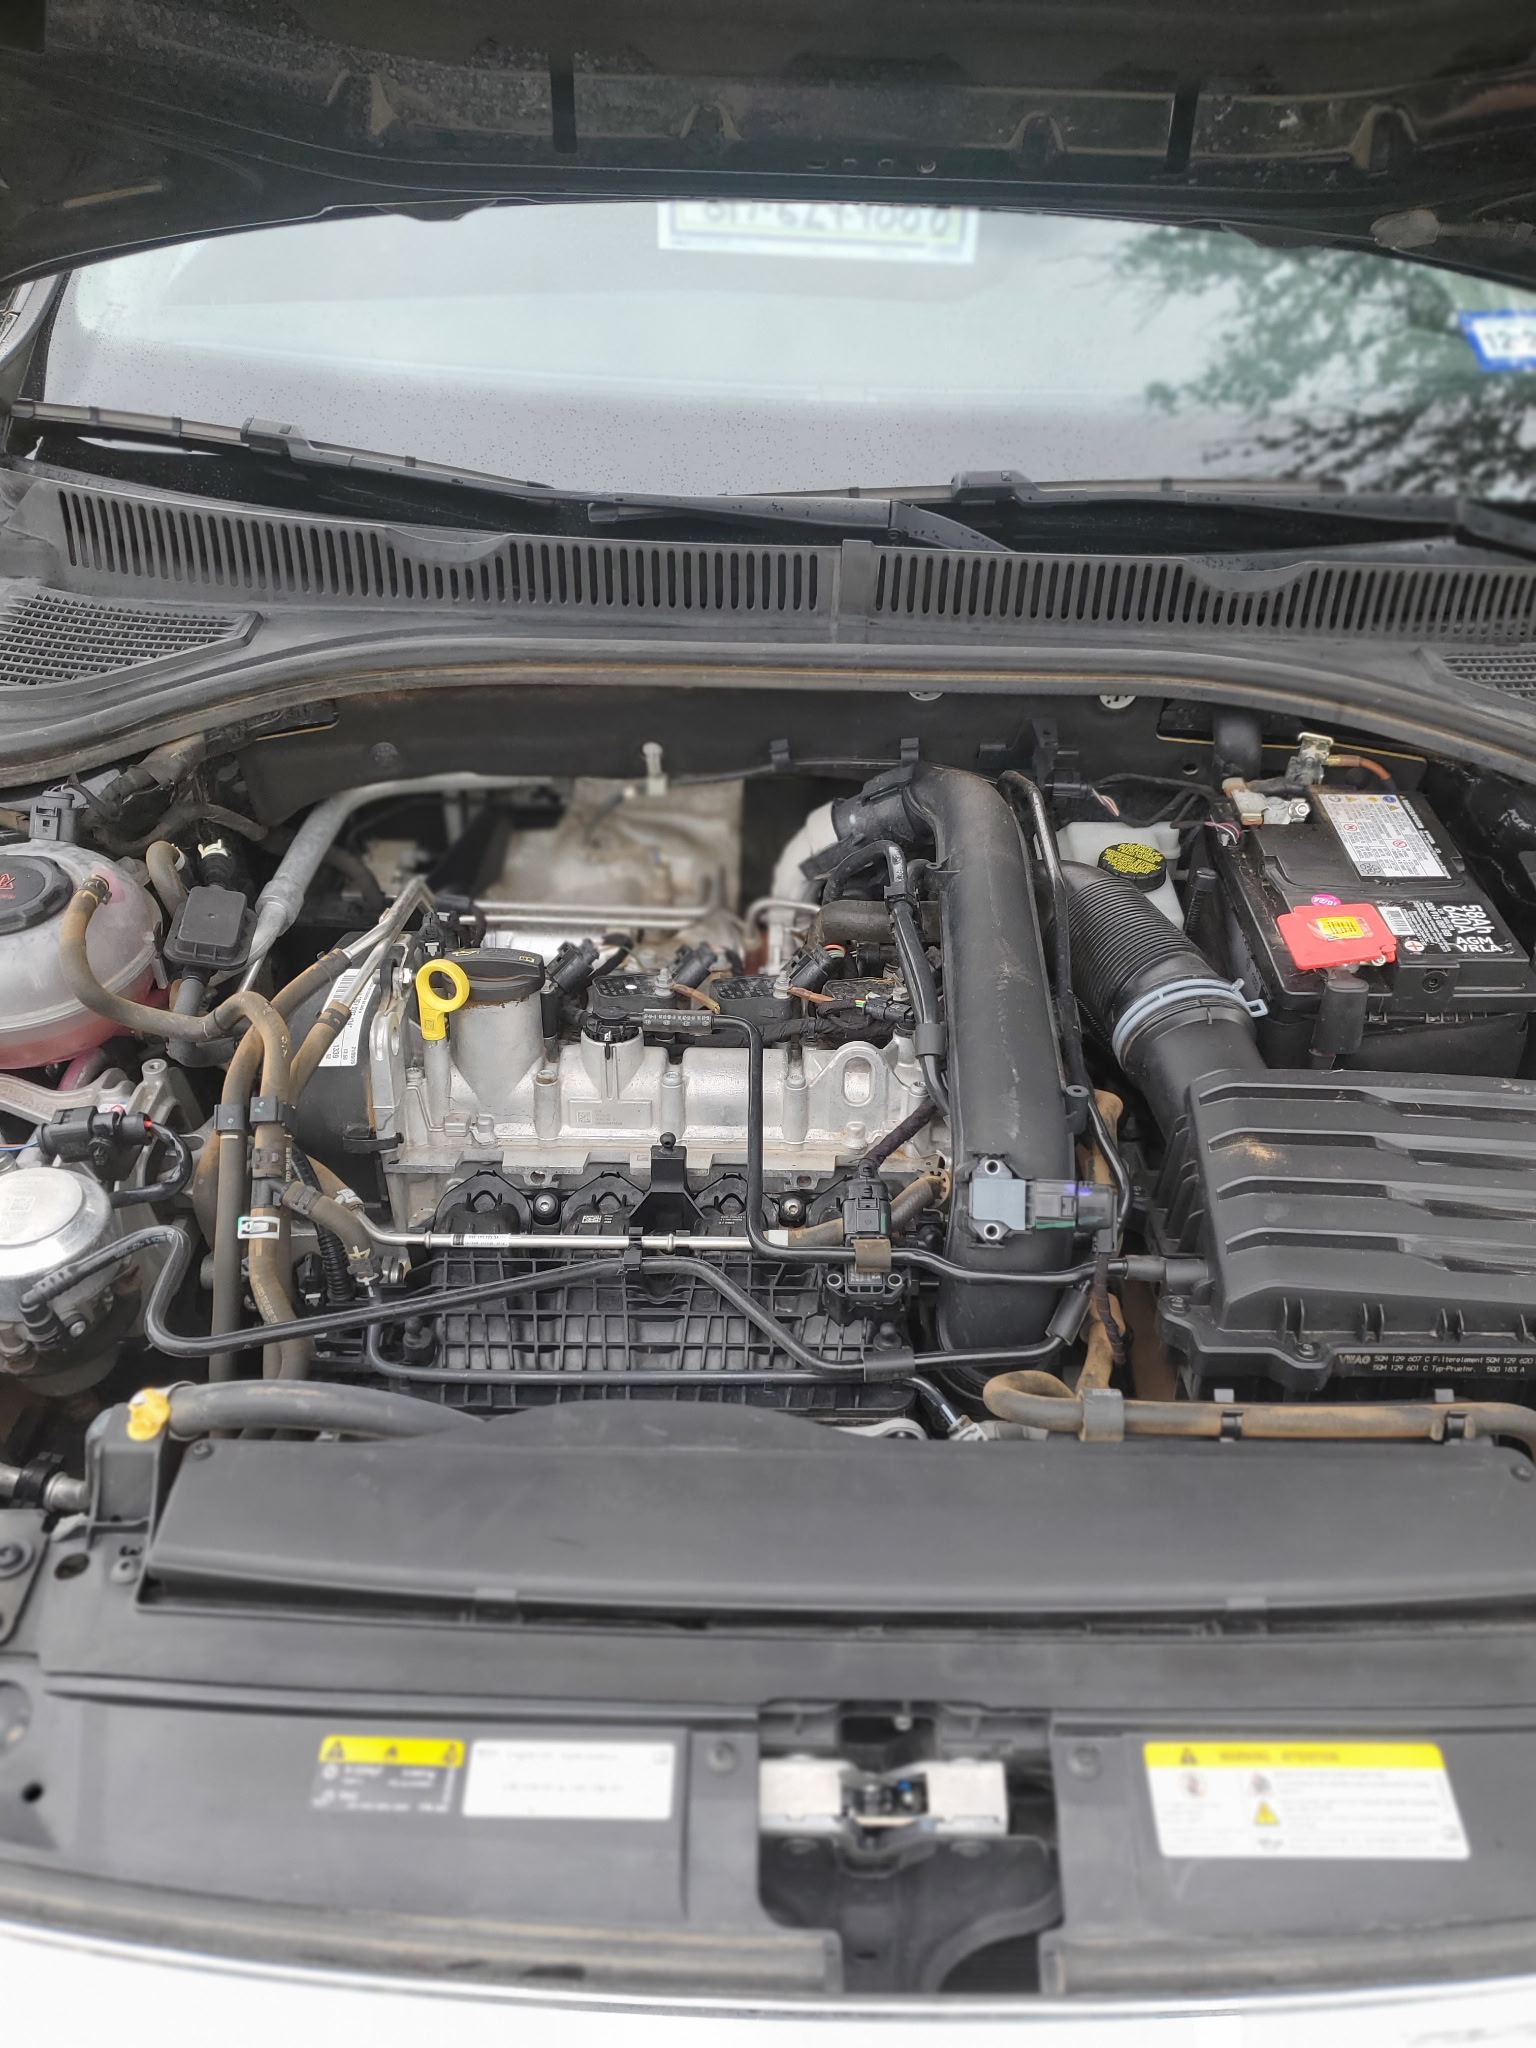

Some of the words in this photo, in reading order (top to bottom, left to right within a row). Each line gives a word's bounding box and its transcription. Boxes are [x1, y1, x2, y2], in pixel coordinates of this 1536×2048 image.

[1442, 905, 1477, 934] 640A
[1461, 904, 1496, 935] 58Ah
[1456, 936, 1494, 945] AGM
[1456, 944, 1504, 953] VRLA
[1432, 1356, 1483, 1364] Filterelement
